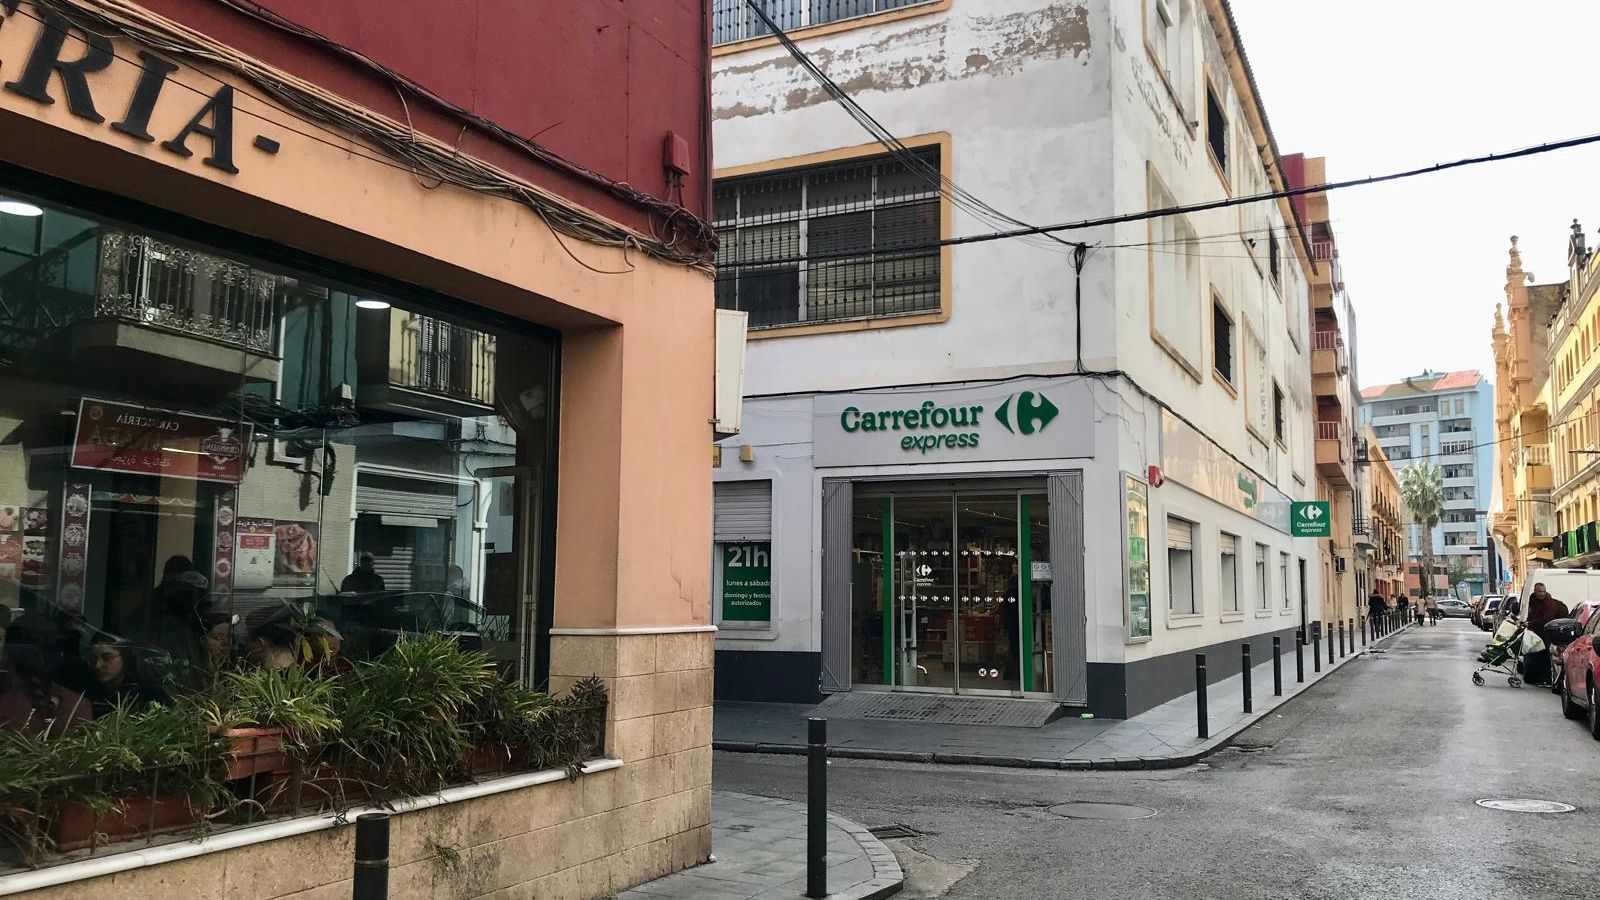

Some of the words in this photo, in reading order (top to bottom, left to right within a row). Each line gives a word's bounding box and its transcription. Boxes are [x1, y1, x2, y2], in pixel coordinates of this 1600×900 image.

[841, 400, 983, 432] Carrefour
[901, 432, 980, 454] express
[728, 545, 768, 567] 21h
[726, 579, 743, 587] lunes
[749, 578, 771, 587] sábado
[724, 592, 748, 600] domingo
